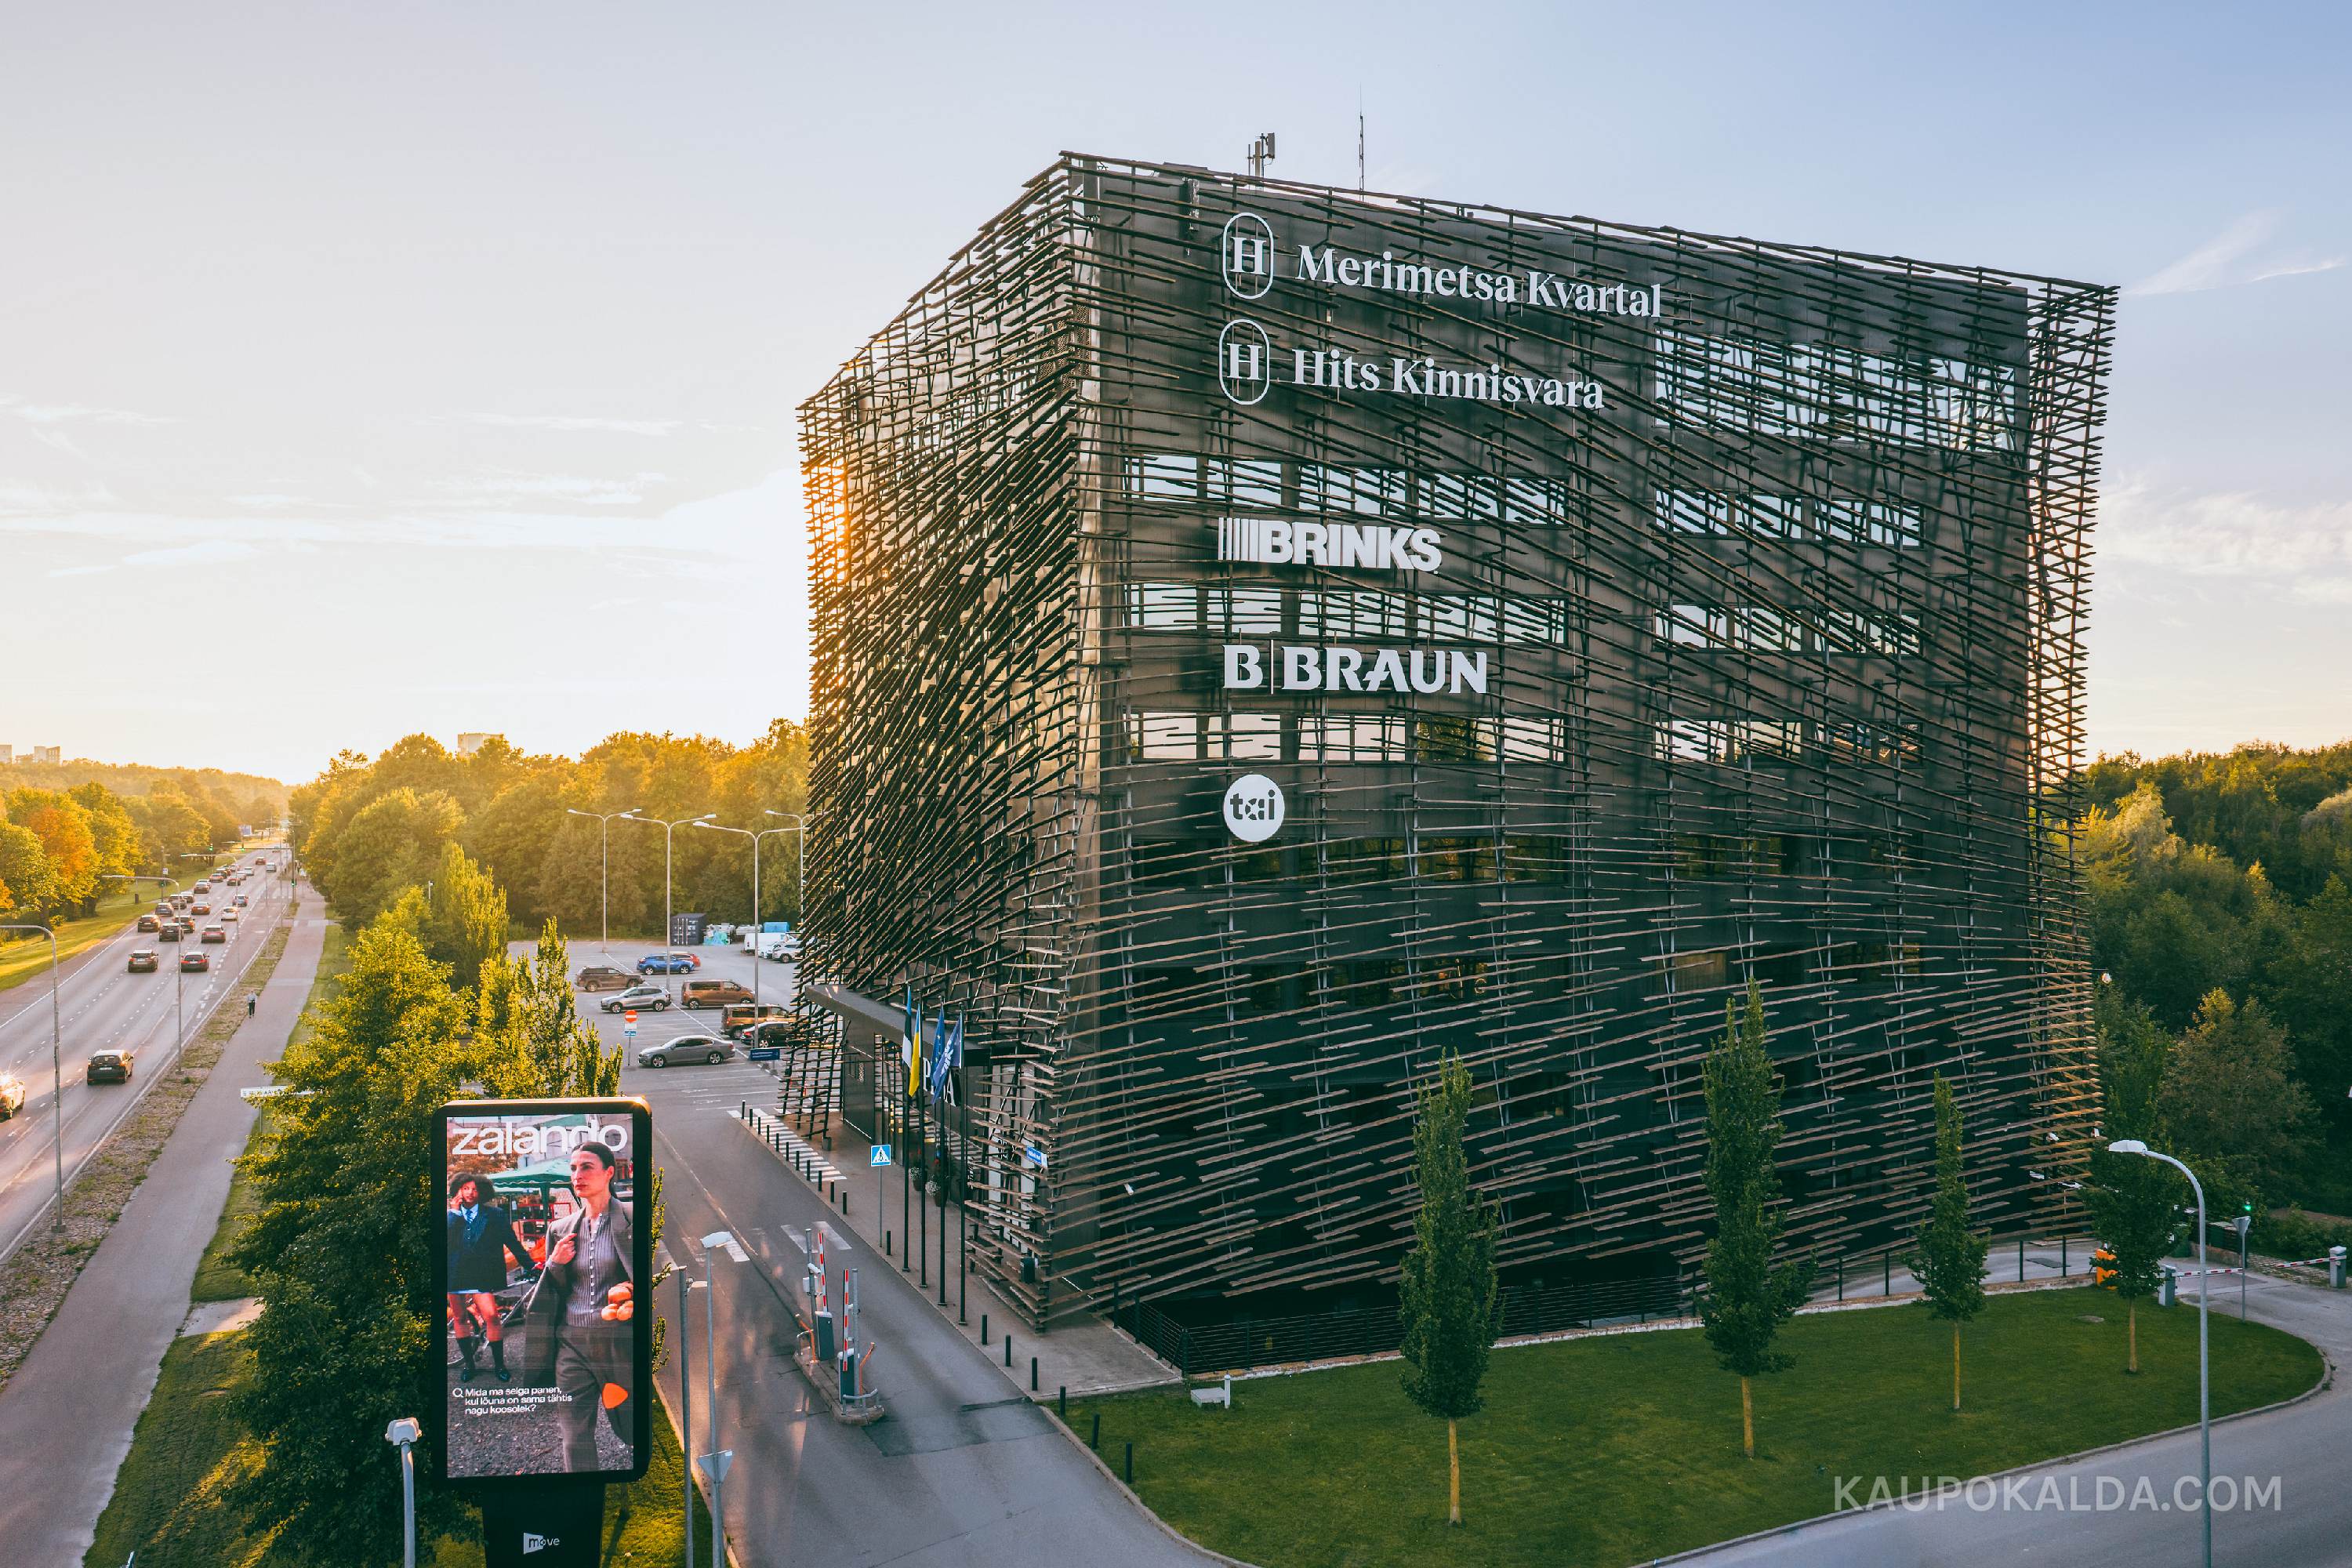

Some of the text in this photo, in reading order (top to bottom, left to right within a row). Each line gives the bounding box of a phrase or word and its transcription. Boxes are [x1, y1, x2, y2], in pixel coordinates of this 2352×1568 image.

[1294, 243, 1662, 319] Merimetsa Kvartal
[1291, 348, 1606, 410] Hits Kinnisvara
[1258, 519, 1443, 572] BRINKS
[1281, 646, 1487, 694] BRAUN
[452, 1119, 629, 1156] zalando
[465, 1388, 488, 1397] Mida
[506, 1387, 529, 1396] selga
[531, 1387, 562, 1396] panen,
[465, 1404, 537, 1417] nagu koosolek?
[480, 1396, 506, 1406] lõuna
[547, 1393, 572, 1403] tähtis
[528, 1537, 561, 1548] move
